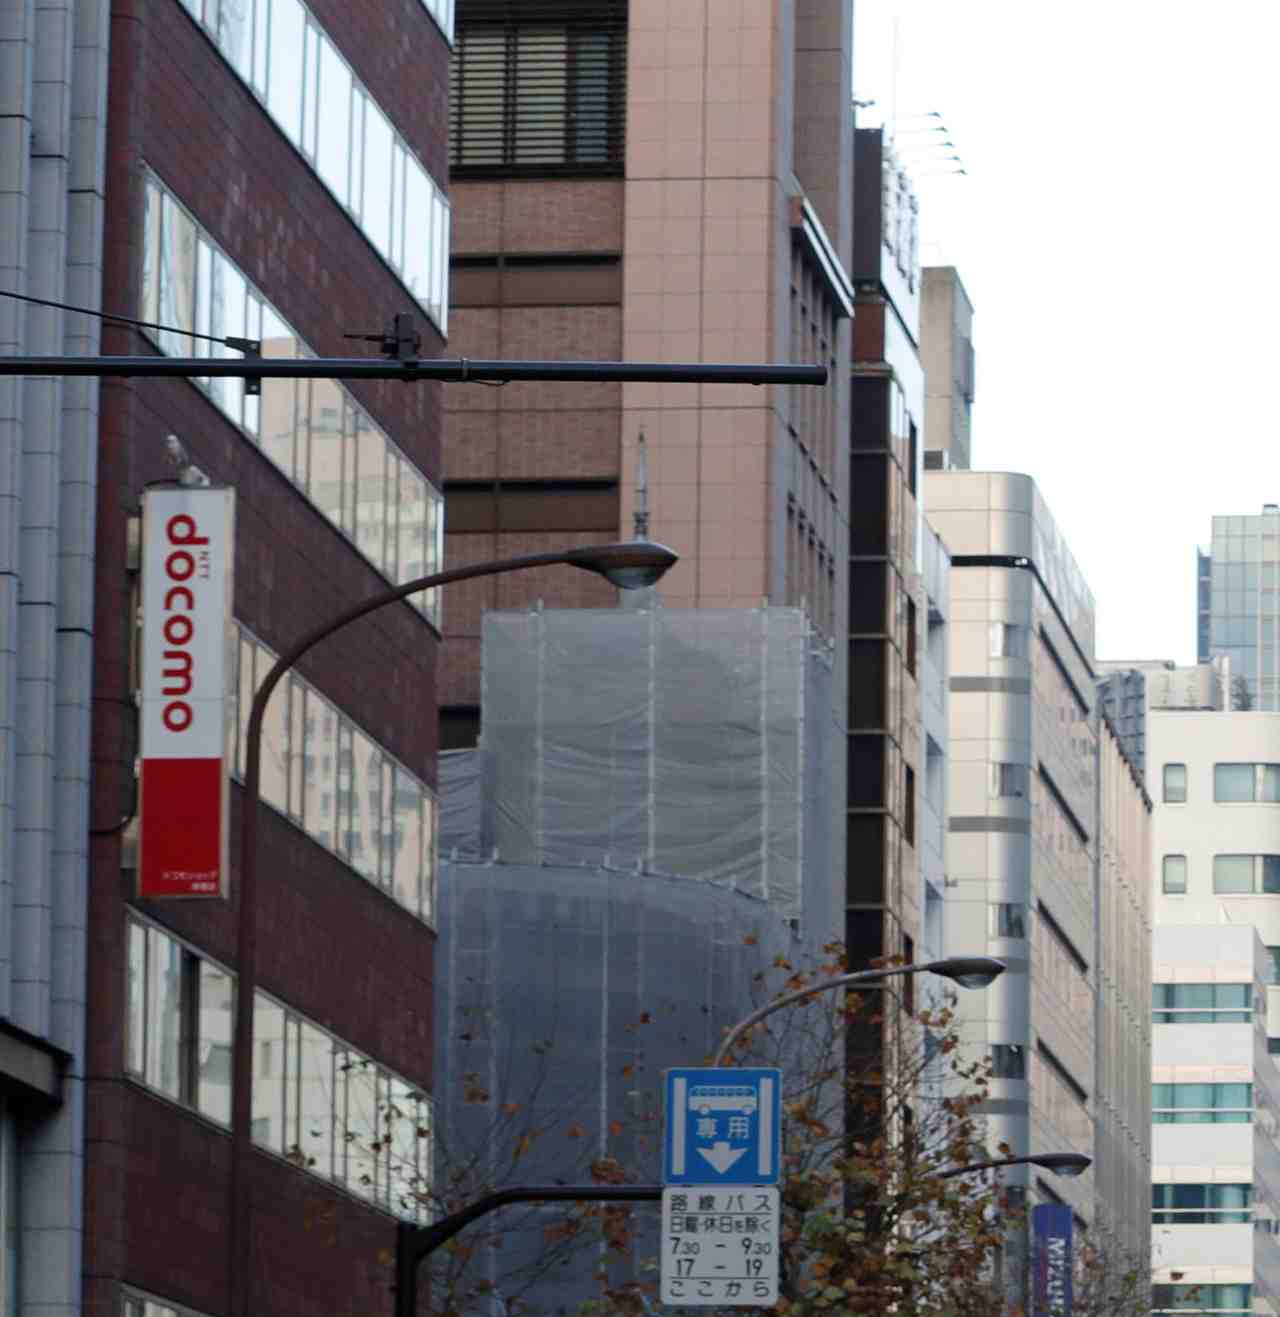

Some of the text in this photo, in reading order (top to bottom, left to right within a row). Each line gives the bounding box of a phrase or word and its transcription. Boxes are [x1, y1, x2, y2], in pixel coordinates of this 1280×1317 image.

[161, 513, 210, 733] docomo
[696, 1117, 750, 1139] 専用
[670, 1194, 772, 1212] 路線バス
[675, 1259, 695, 1276] 17
[744, 1259, 764, 1276] 19
[669, 1280, 771, 1298] ここから
